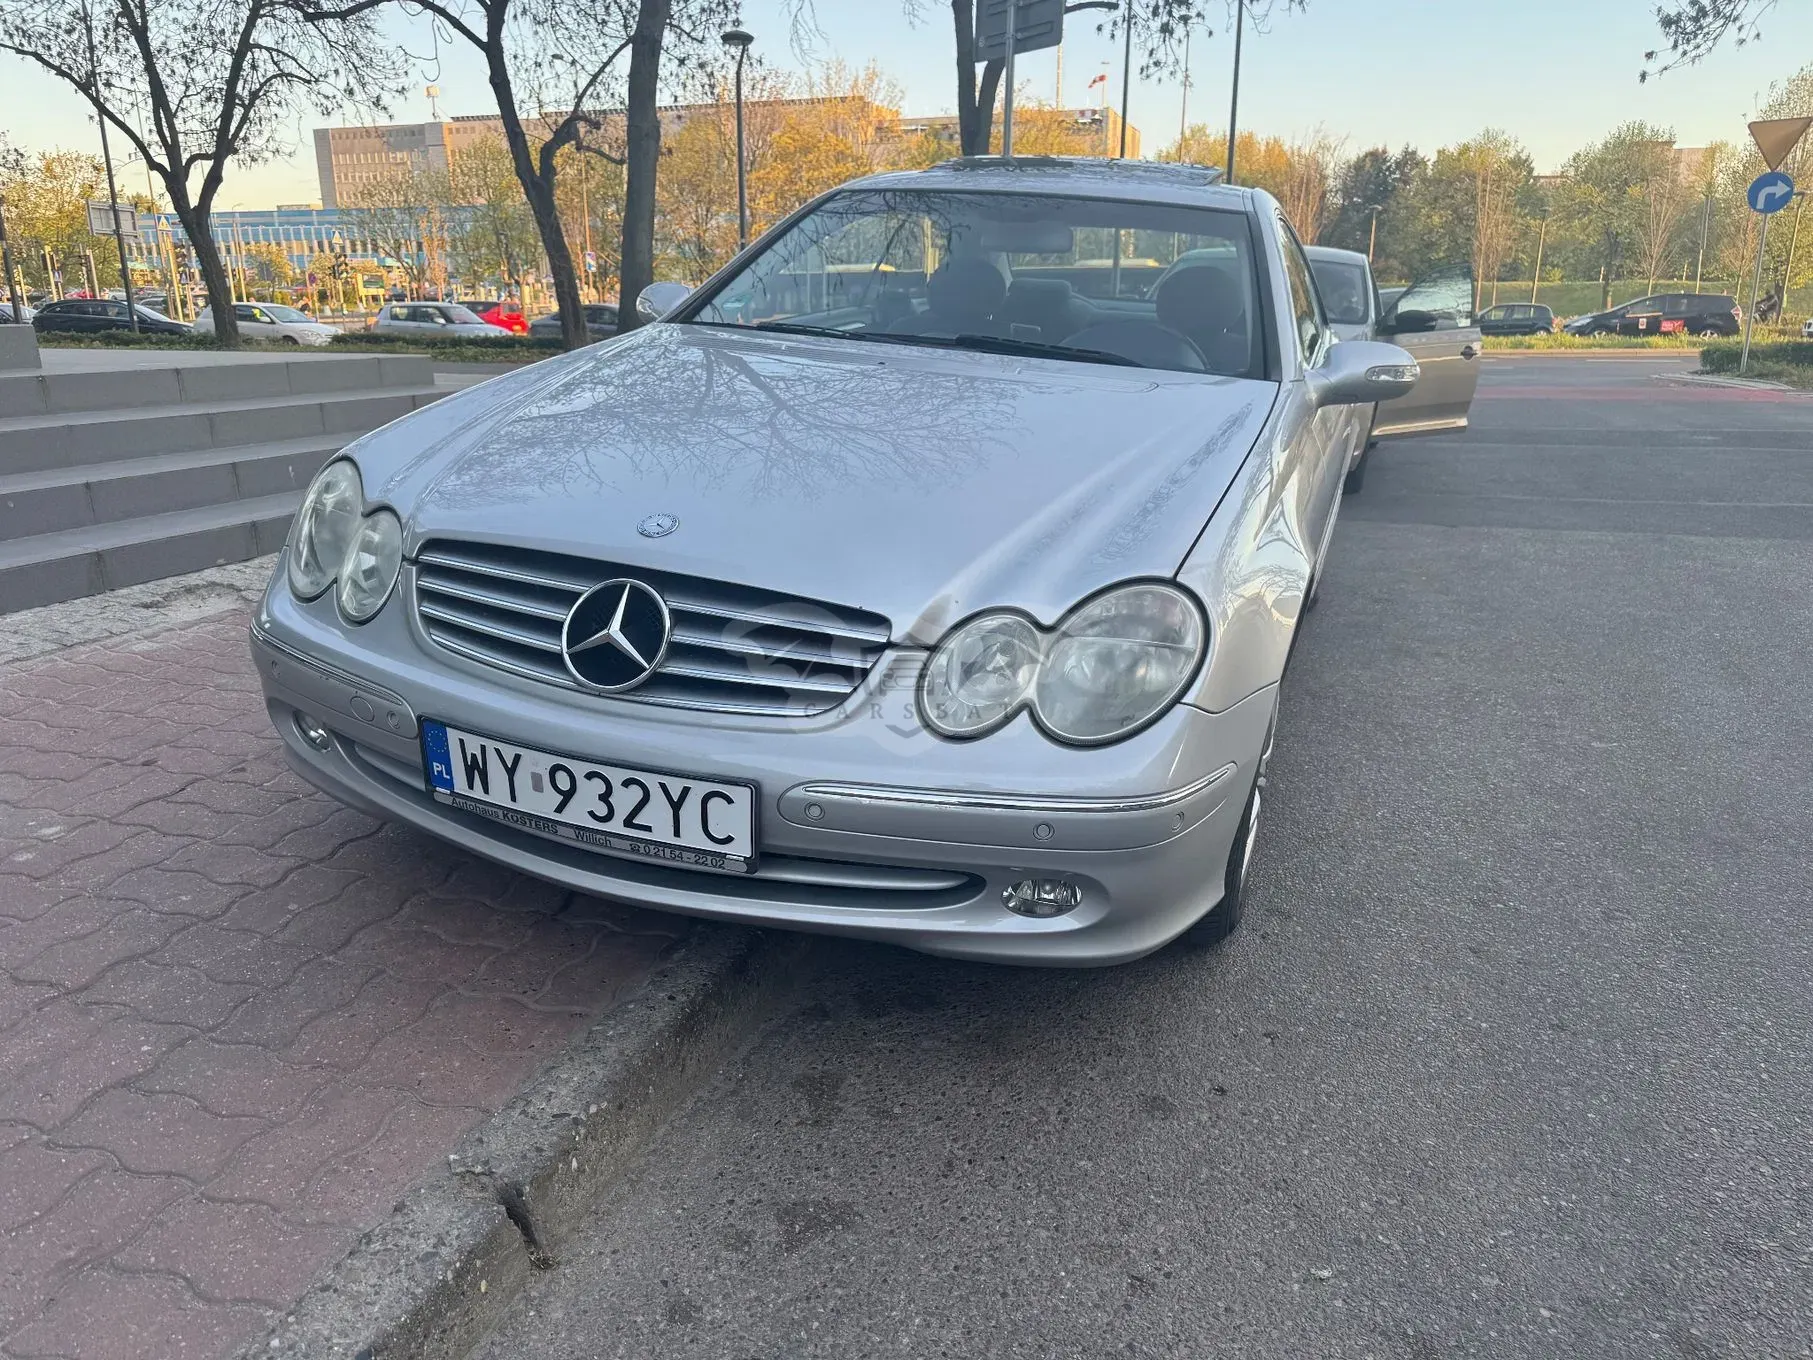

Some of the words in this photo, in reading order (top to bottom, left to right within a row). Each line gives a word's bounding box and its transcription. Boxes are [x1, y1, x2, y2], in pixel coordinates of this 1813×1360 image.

[433, 761, 450, 779] PL
[459, 738, 522, 803] WY
[548, 763, 735, 845] 932YC
[451, 798, 499, 818] Autohaus
[573, 828, 612, 848] Willich
